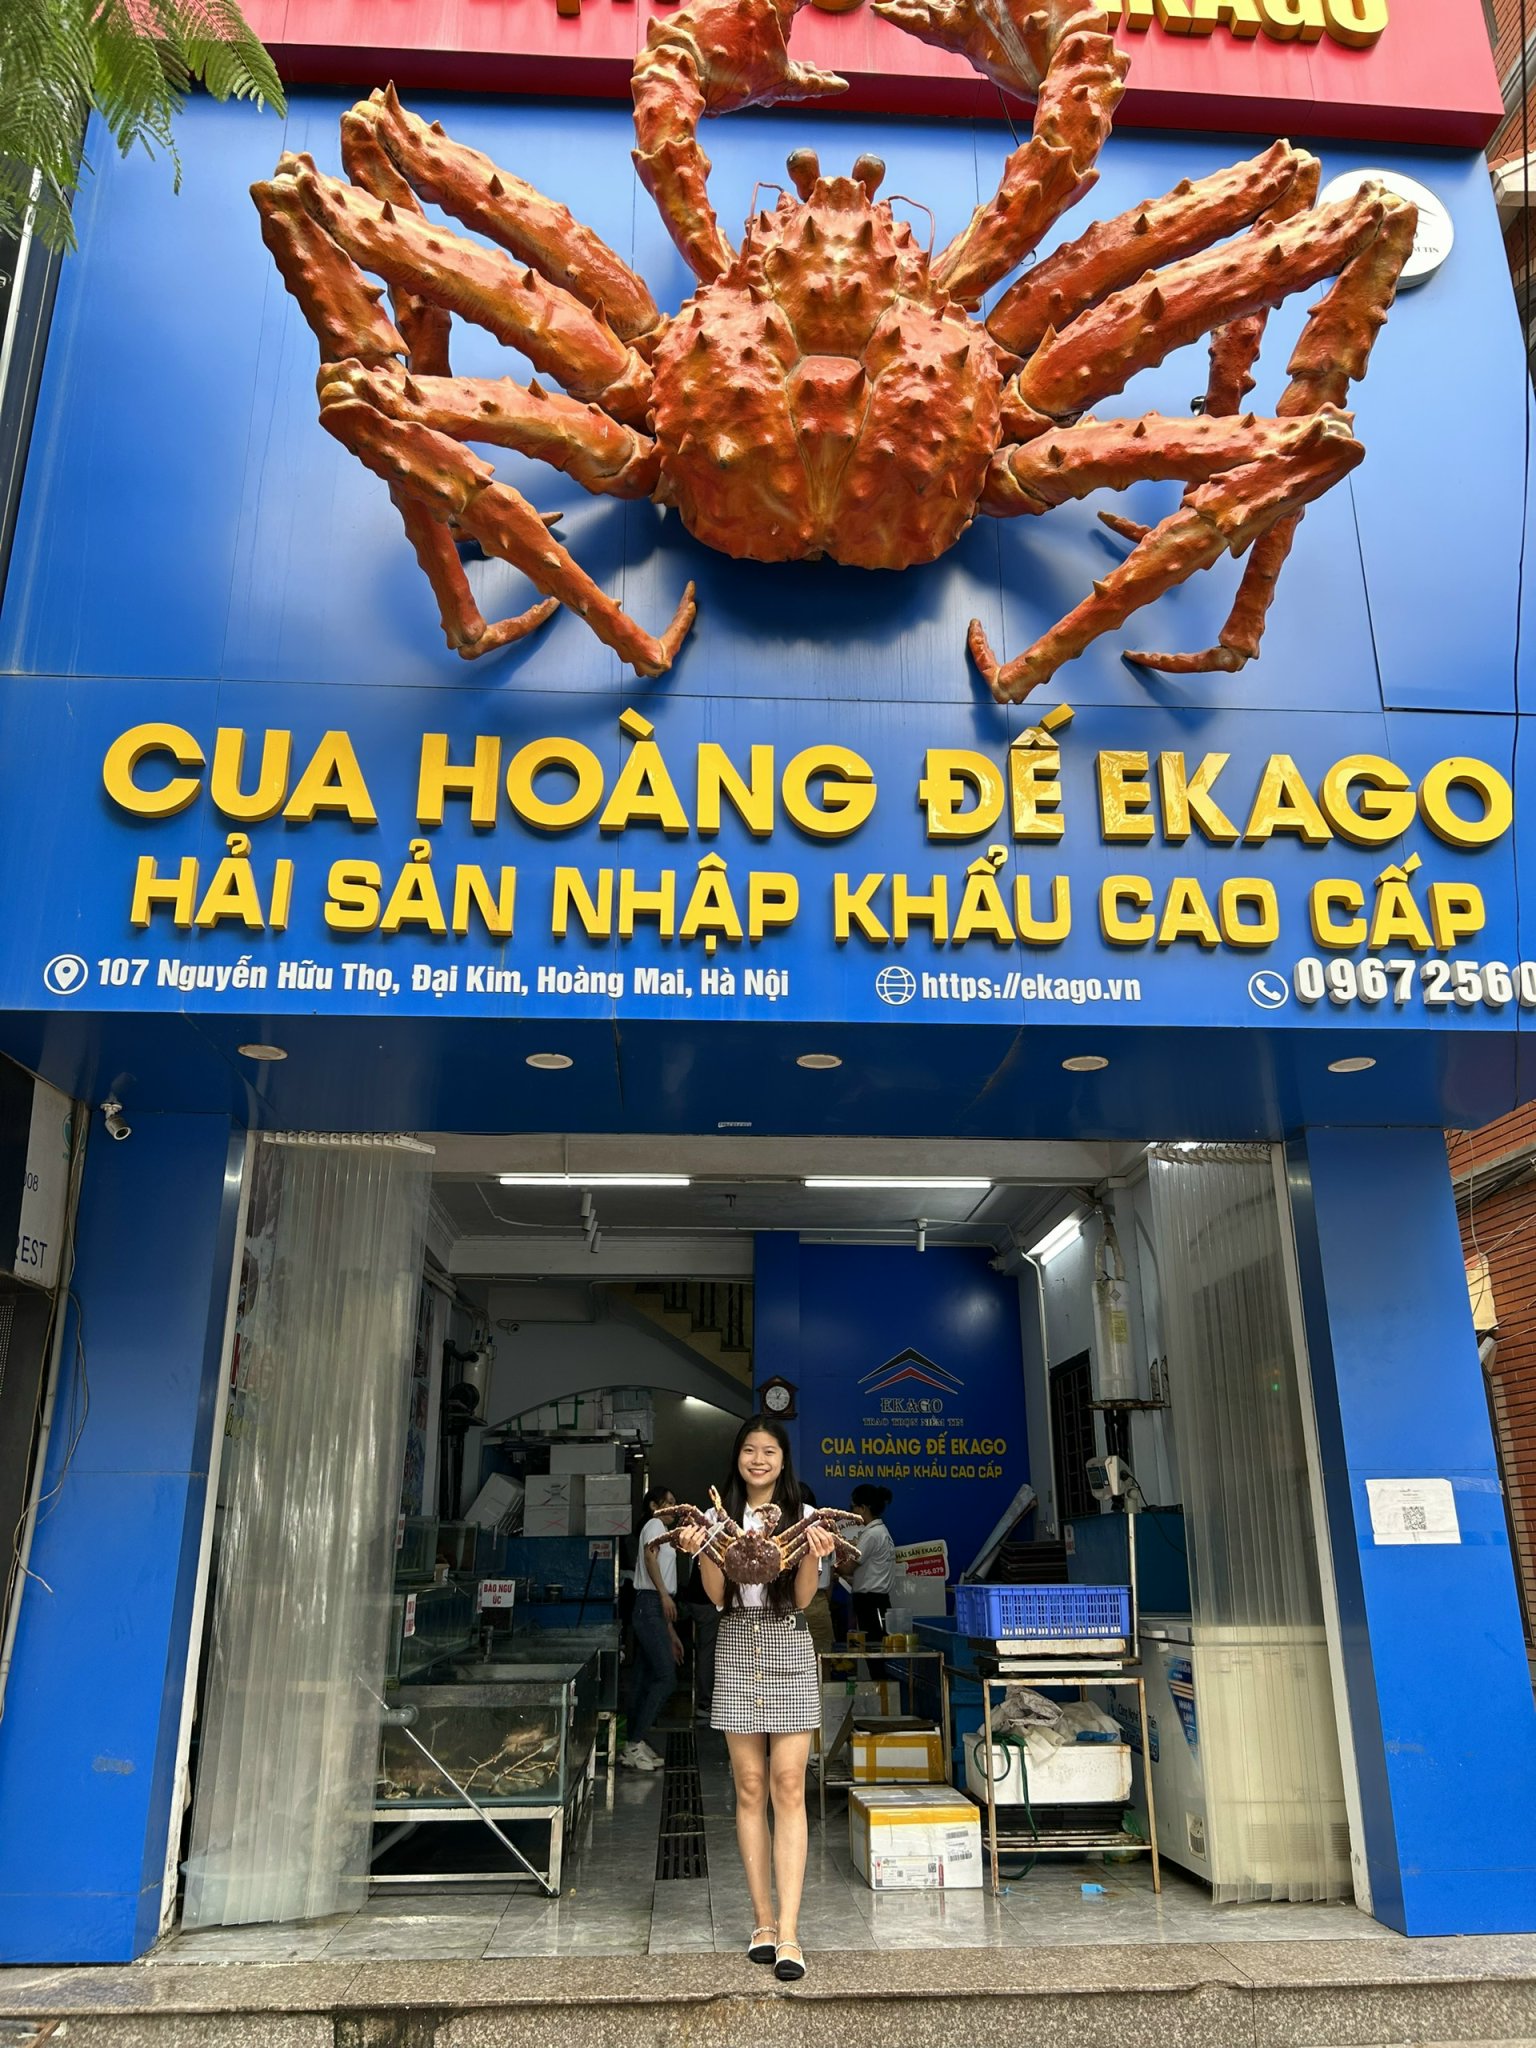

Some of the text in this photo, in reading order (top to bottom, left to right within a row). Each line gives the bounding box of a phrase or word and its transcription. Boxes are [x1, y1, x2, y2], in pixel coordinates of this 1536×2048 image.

[103, 703, 1513, 848] CUA HOÀNG ĐẾ EKAGO
[130, 832, 1487, 955] HẢI SẢN NHẬP KHẨU CAO CẤP
[97, 955, 789, 1002] 107 Nguyễn Hữu Thọ, Đại Kim, Hoàng Mai, Hà Nội
[921, 972, 1141, 1005] https://ekago.vn
[16, 1235, 48, 1269] EST
[880, 1397, 943, 1413] EKAGO
[821, 1431, 1007, 1456] CUA HOÀNG ĐẾ EKAGO
[825, 1457, 1003, 1480] HẢI SẢN NHẬP KHẨU CAO CẤP
